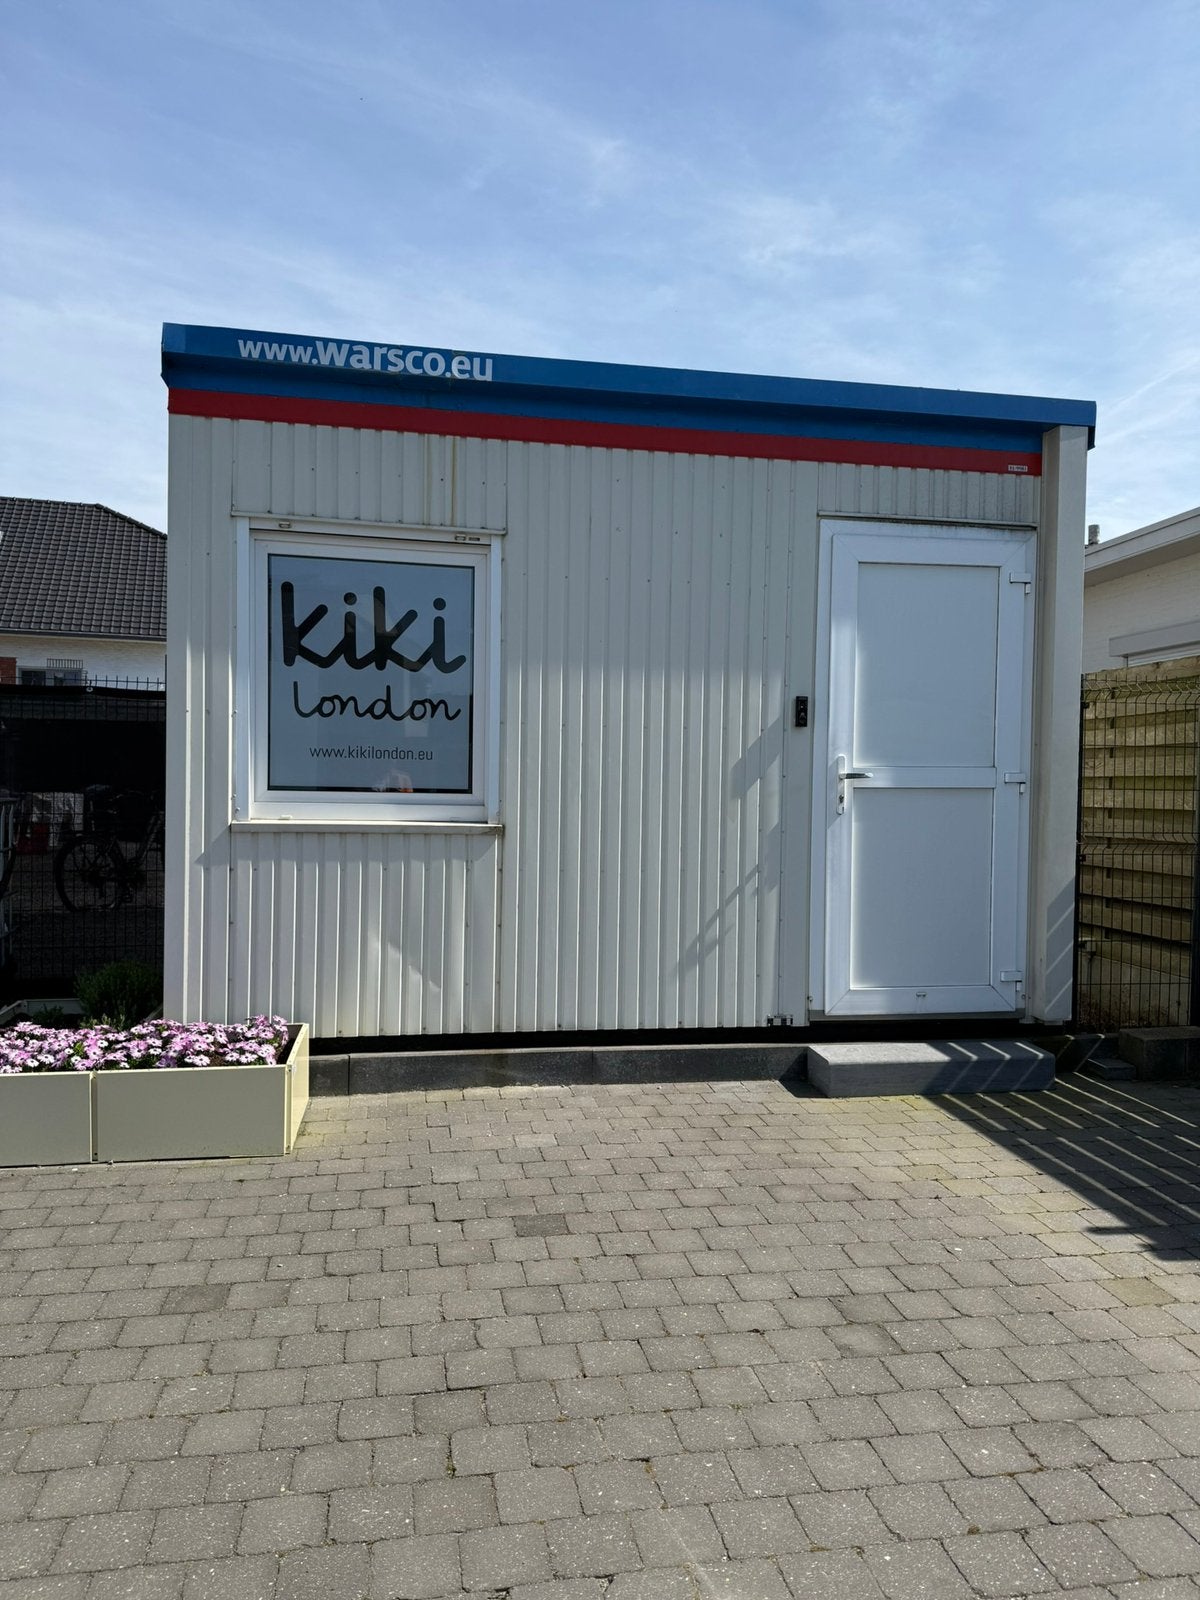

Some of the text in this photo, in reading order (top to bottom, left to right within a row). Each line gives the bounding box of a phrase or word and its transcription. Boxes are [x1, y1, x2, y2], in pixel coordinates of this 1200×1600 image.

[238, 339, 493, 381] www.Warsco.eu
[281, 581, 466, 674] kiki
[293, 681, 461, 721] london
[309, 746, 434, 761] www.kikilondon.eu
